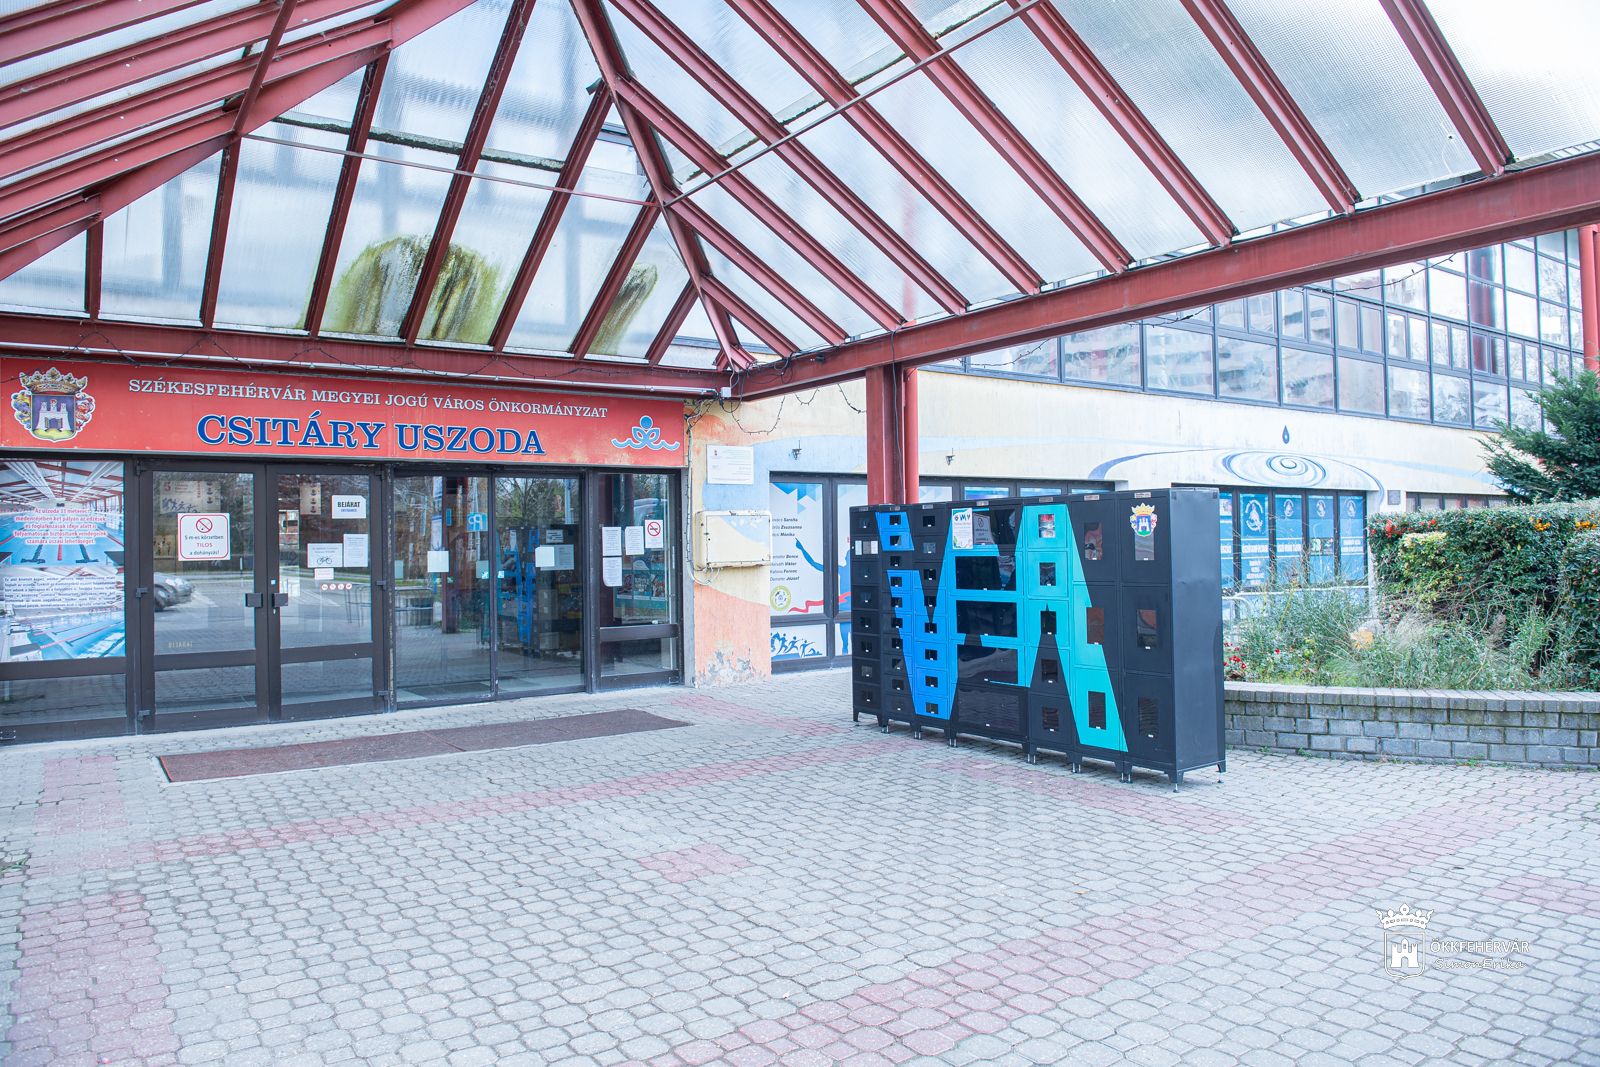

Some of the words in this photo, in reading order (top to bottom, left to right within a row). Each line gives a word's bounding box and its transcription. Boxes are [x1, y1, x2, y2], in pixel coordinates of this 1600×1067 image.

[128, 377, 307, 401] SZÉKESFEHÉRVÁR
[312, 389, 380, 405] MEGYEI
[385, 393, 429, 408] JOGÚ
[433, 395, 485, 411] VÁROS
[488, 398, 608, 418] ÖNKORMÁNYZAT
[196, 410, 386, 449] CSITÁRY
[395, 423, 546, 455] USZODA
